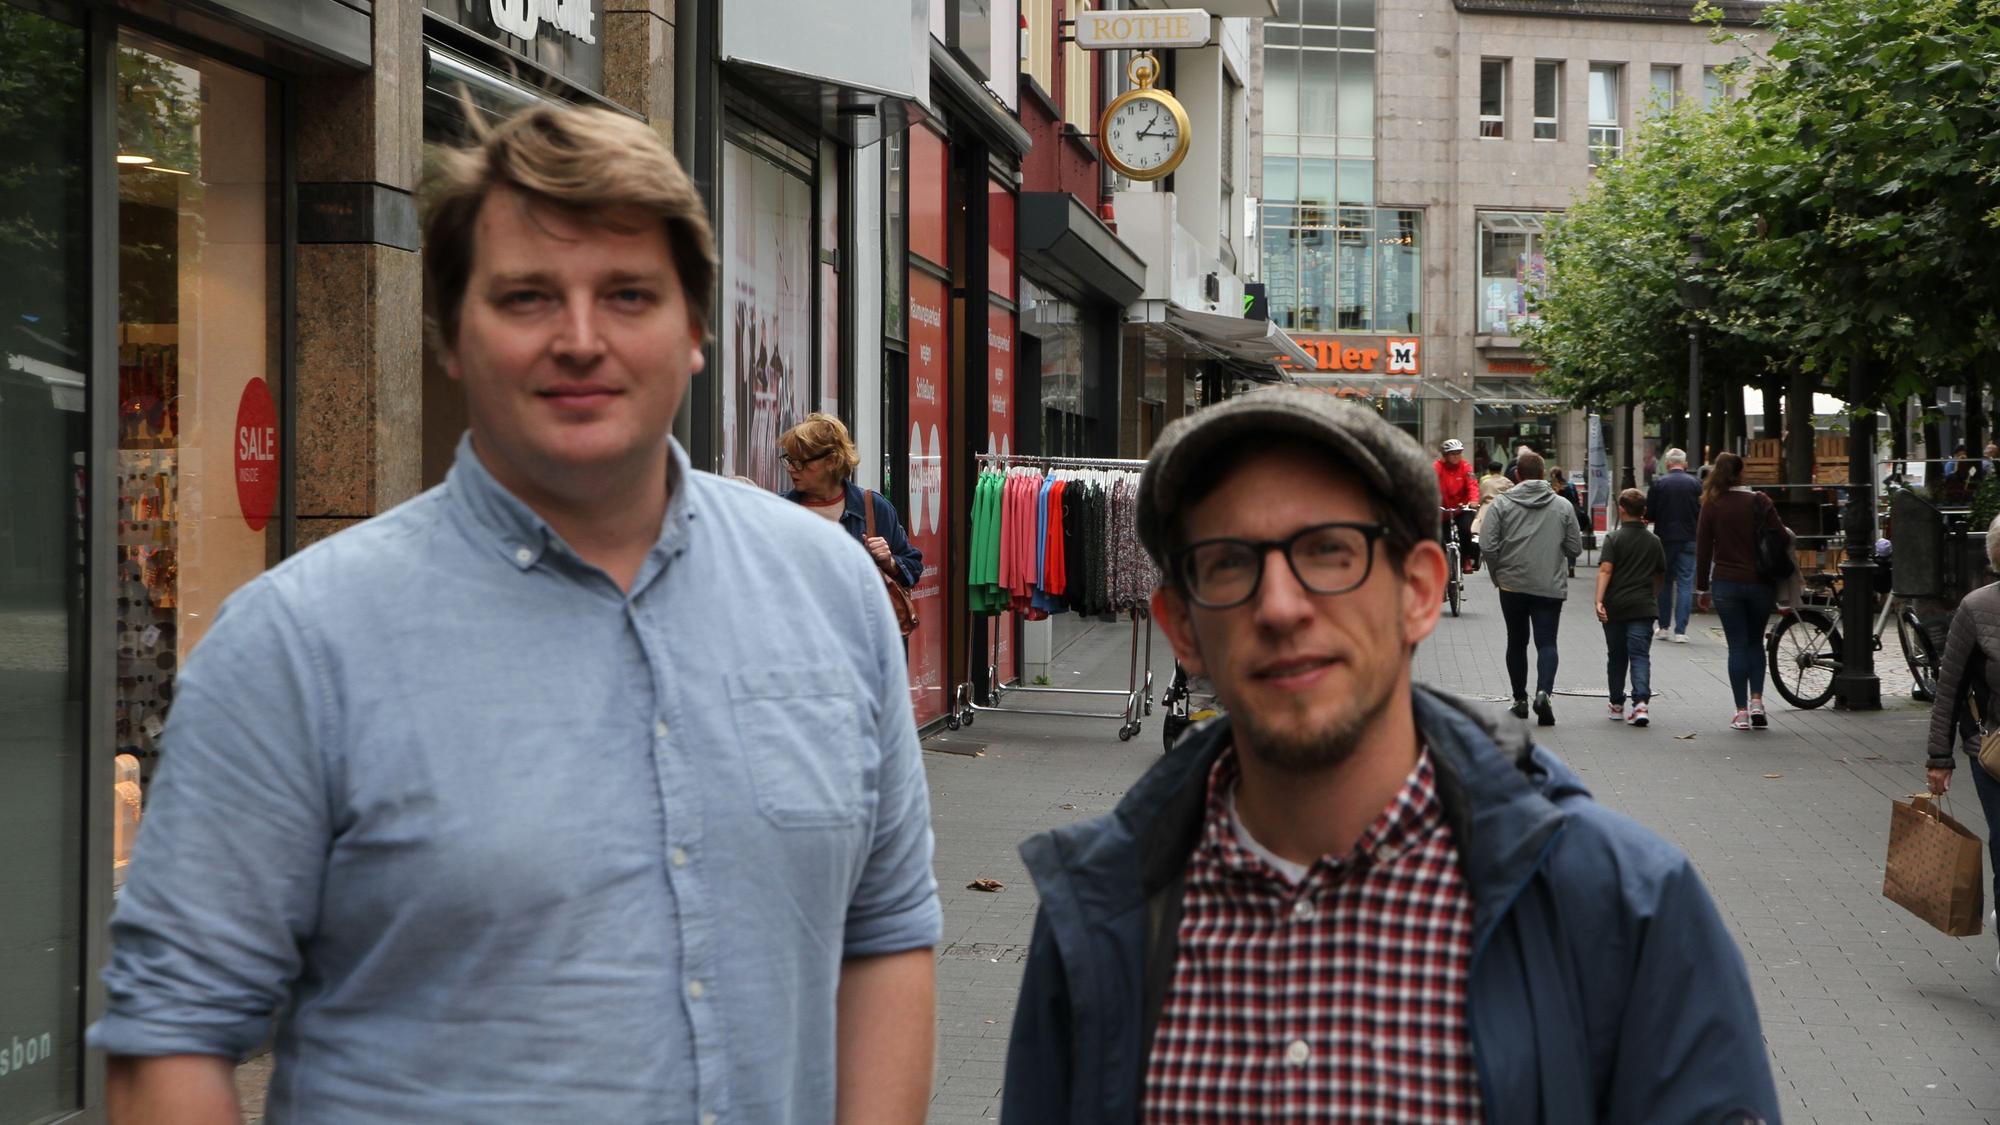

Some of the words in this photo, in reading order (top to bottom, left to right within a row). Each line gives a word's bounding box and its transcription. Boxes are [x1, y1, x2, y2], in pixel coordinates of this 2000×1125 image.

[1092, 16, 1191, 40] ROTHE
[1128, 106, 1134, 115] 11
[1139, 102, 1148, 112] 12
[1117, 117, 1125, 126] 10
[1164, 115, 1171, 125] 2
[1113, 130, 1120, 139] 9
[1118, 144, 1124, 153] 8
[1140, 156, 1148, 166] 6
[1154, 152, 1161, 162] 5
[1394, 348, 1411, 364] M
[239, 426, 275, 461] SALE
[239, 467, 259, 482] INSIDE
[0, 1031, 51, 1076] sbon
